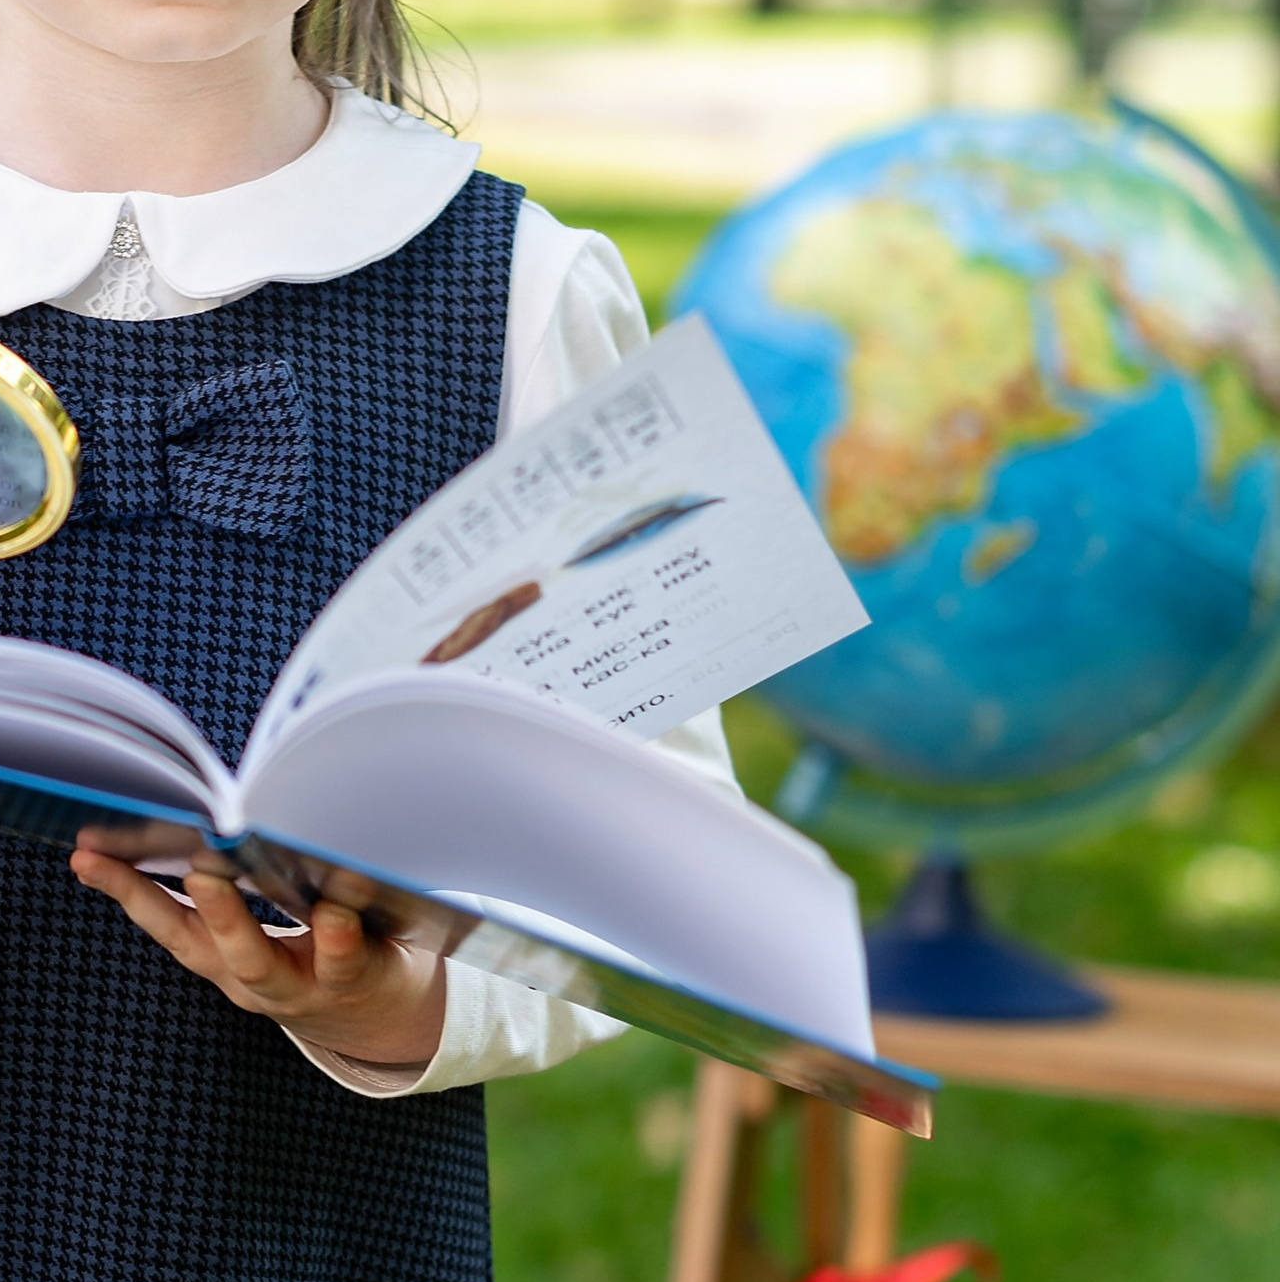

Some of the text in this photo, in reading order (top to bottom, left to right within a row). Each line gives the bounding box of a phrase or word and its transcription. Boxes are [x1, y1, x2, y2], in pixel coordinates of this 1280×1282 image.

[514, 546, 700, 655] кук кик нку
[524, 636, 571, 667] кна
[592, 601, 637, 629] кук
[662, 558, 711, 590] нки
[571, 618, 671, 676] мис-ка
[582, 637, 671, 689] кас-ка
